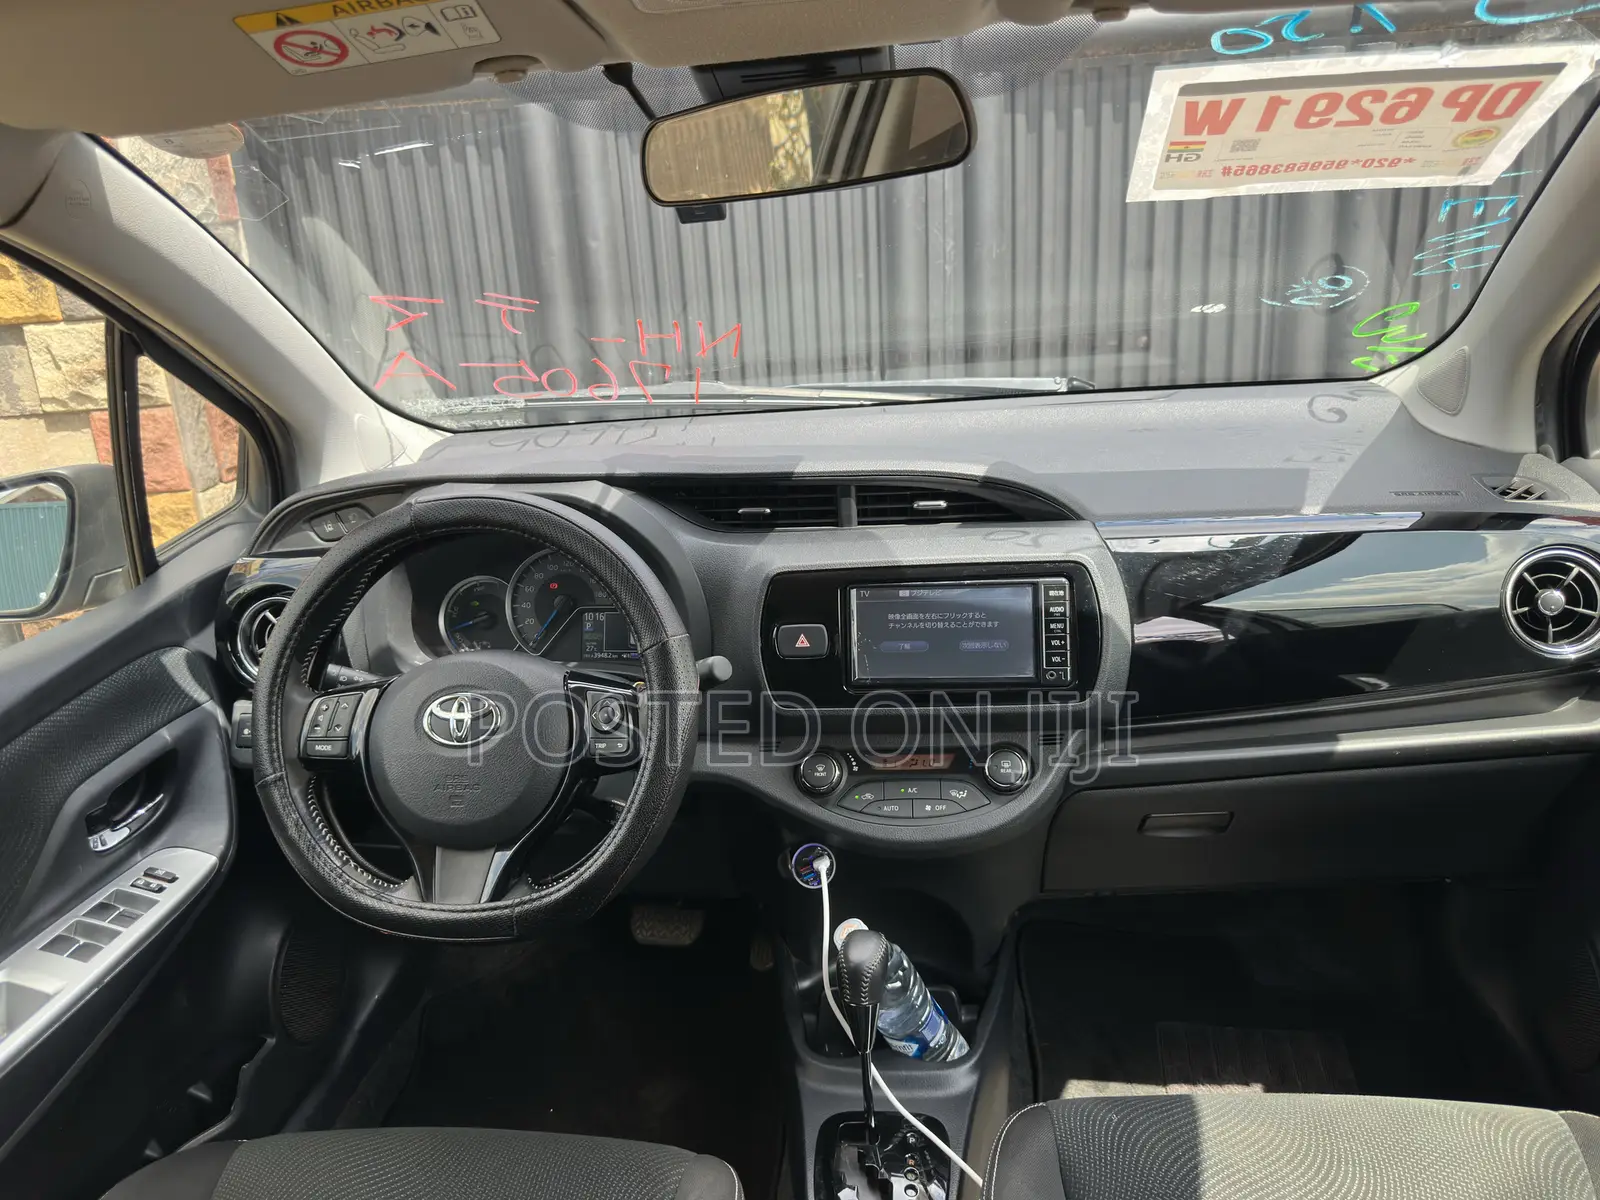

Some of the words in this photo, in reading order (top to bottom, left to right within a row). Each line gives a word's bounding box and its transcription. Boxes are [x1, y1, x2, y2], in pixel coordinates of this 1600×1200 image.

[332, 0, 433, 17] AIRB
[525, 585, 535, 593] 60
[859, 590, 870, 598] TV
[521, 601, 531, 609] 40
[524, 617, 535, 625] 20
[315, 744, 333, 752] MODE
[432, 783, 482, 792] AIRBAG
